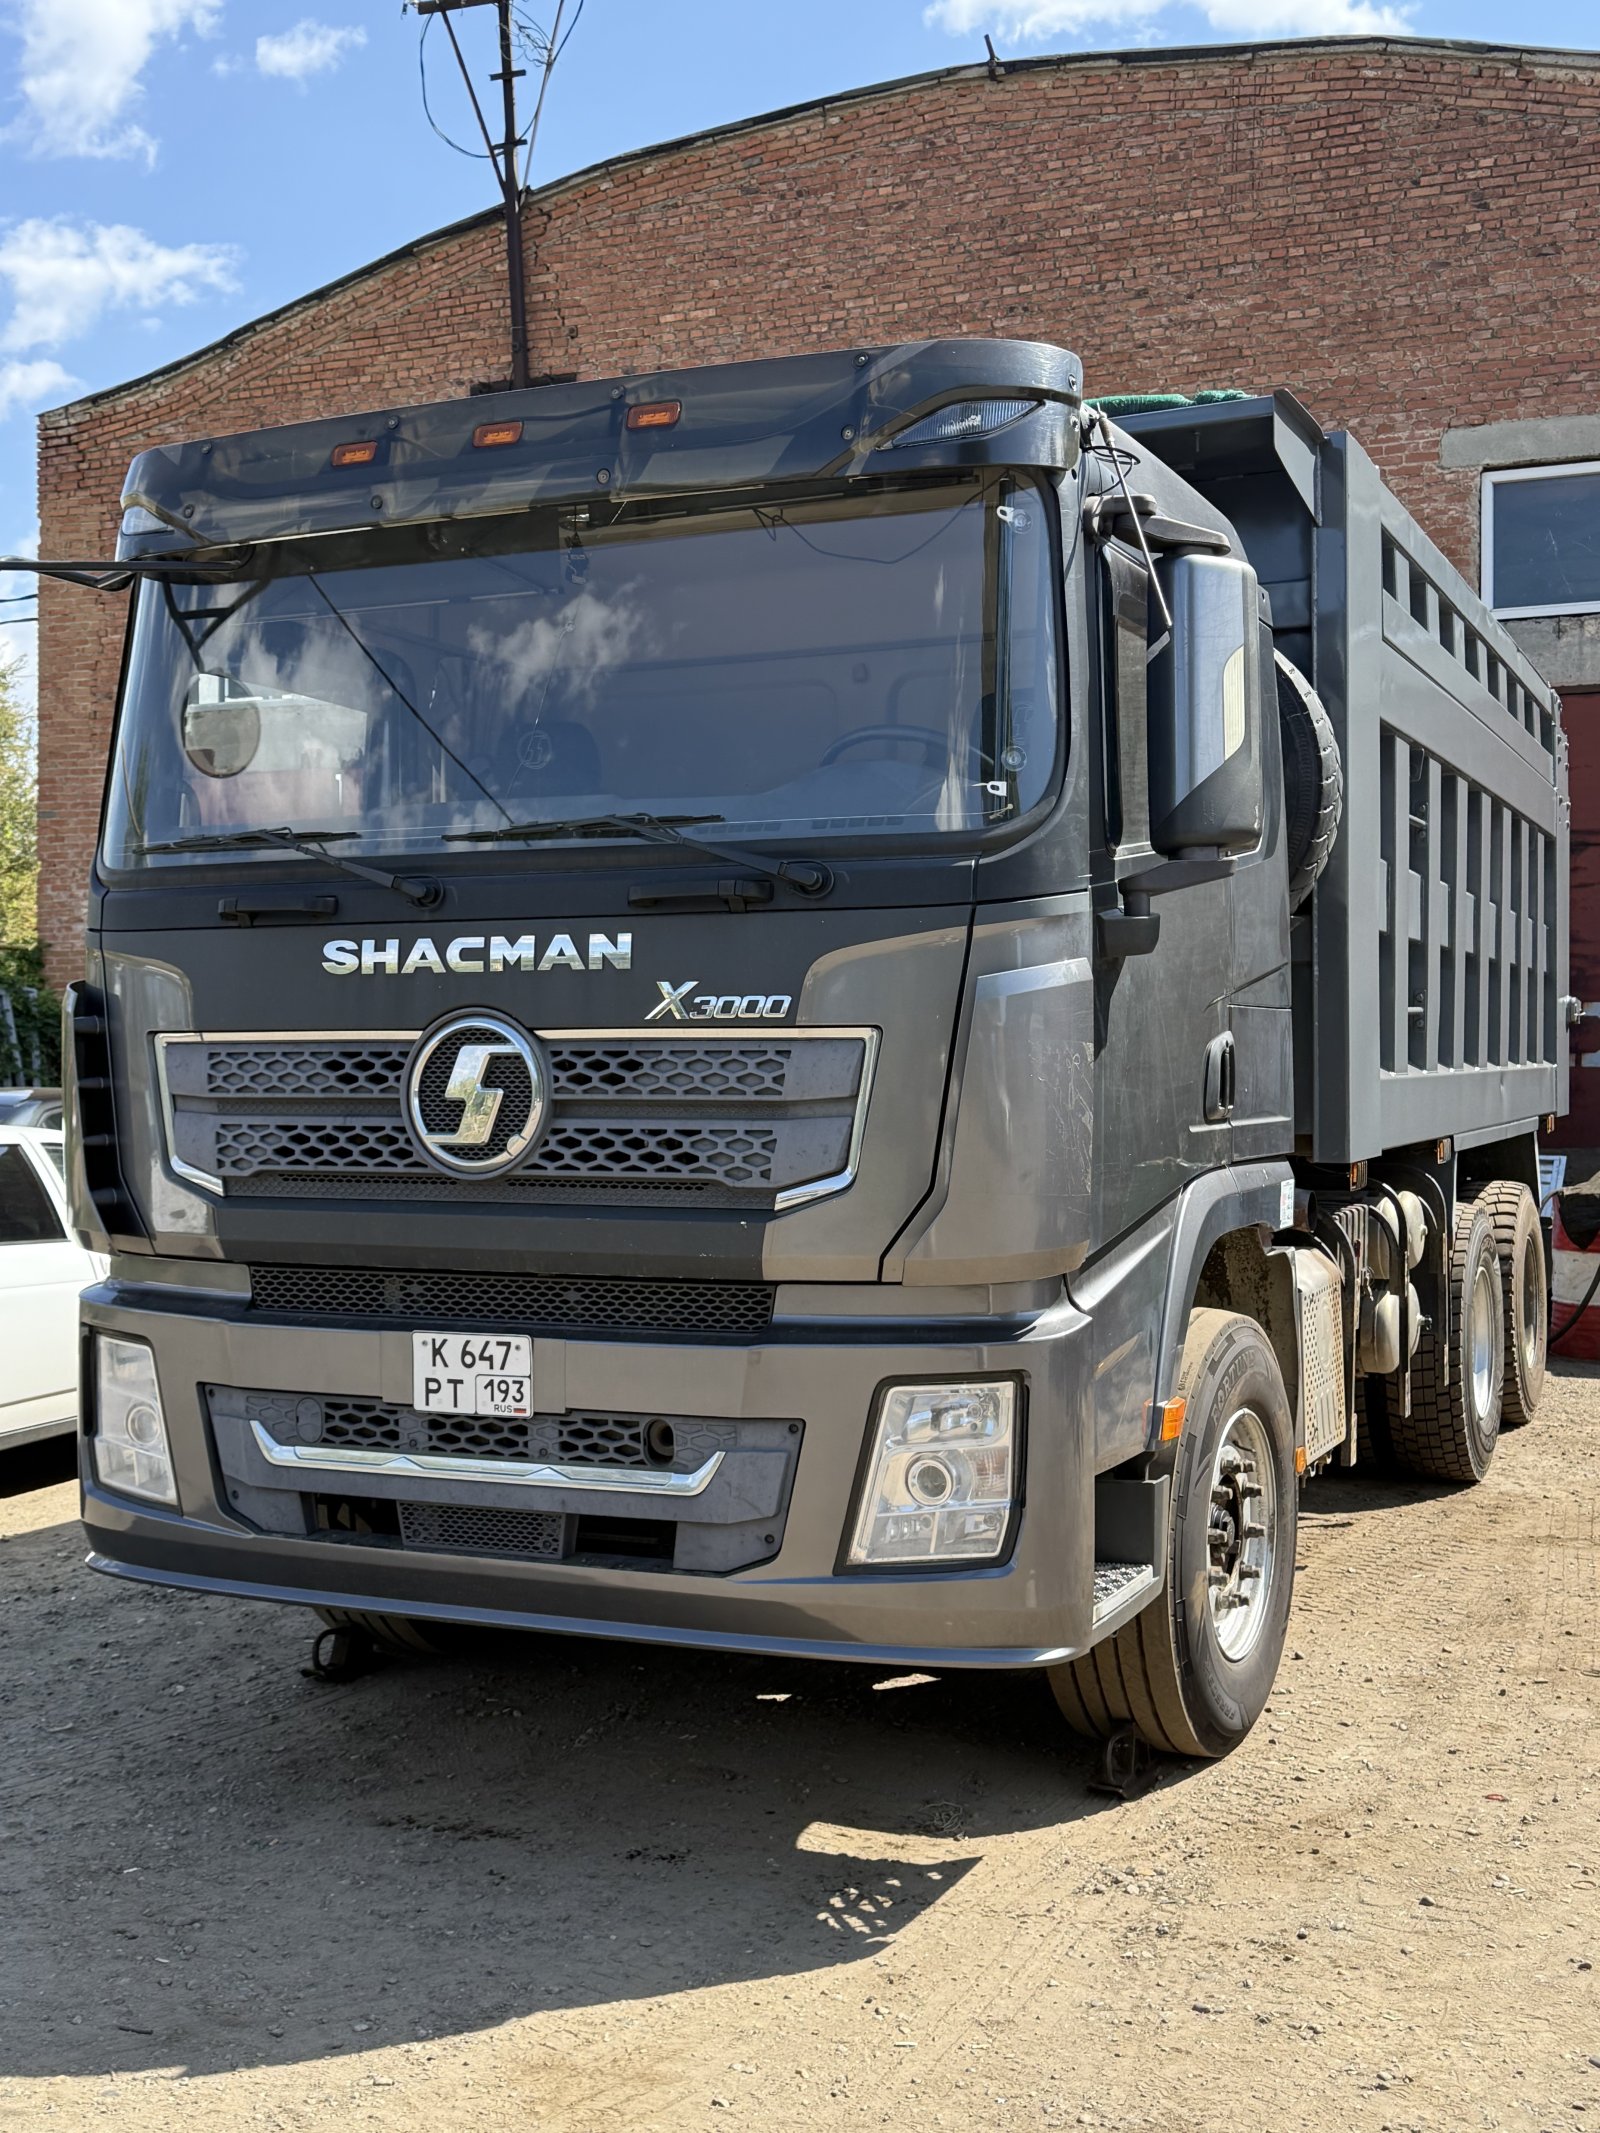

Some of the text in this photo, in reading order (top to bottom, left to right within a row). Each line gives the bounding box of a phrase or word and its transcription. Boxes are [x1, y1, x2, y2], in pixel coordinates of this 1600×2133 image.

[321, 932, 633, 975] SHACMAN
[644, 980, 793, 1020] X3000
[460, 1339, 512, 1371] 647
[483, 1378, 524, 1403] 193
[493, 1403, 513, 1414] RUS
